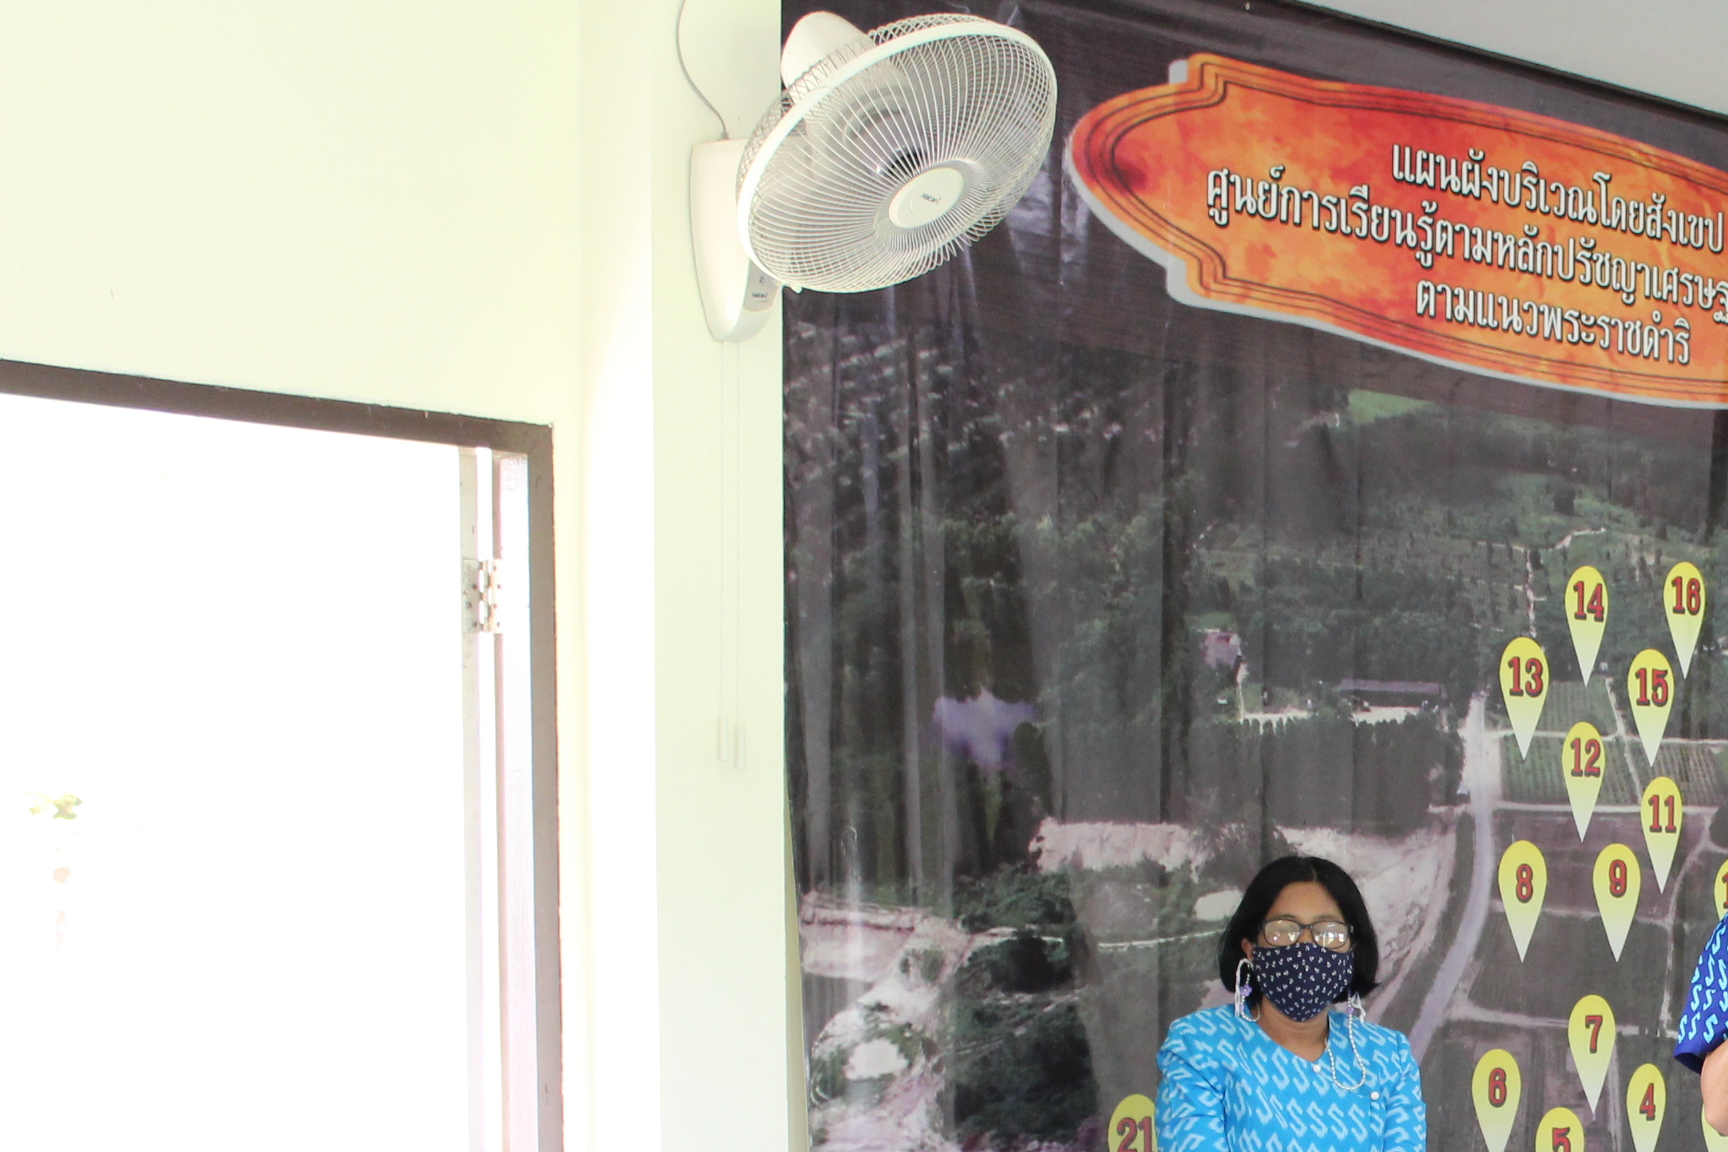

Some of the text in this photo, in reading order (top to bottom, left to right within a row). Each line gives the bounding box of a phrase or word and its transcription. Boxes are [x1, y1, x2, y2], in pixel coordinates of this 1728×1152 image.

[1391, 140, 1725, 254] แผนผังบริเวณโดยสังเขป
[1415, 277, 1692, 367] ตามแนวพระราชดำริ
[1572, 580, 1605, 622] 14
[1671, 576, 1701, 616] 16
[1507, 656, 1544, 698] 13
[1635, 667, 1669, 707] 15
[1570, 737, 1602, 777] 12
[1648, 794, 1678, 833] 11
[1515, 863, 1534, 902] 8
[1608, 859, 1628, 898] 9
[1585, 1015, 1604, 1054] 7
[1488, 1068, 1508, 1107] 6
[1639, 1083, 1656, 1121] 4
